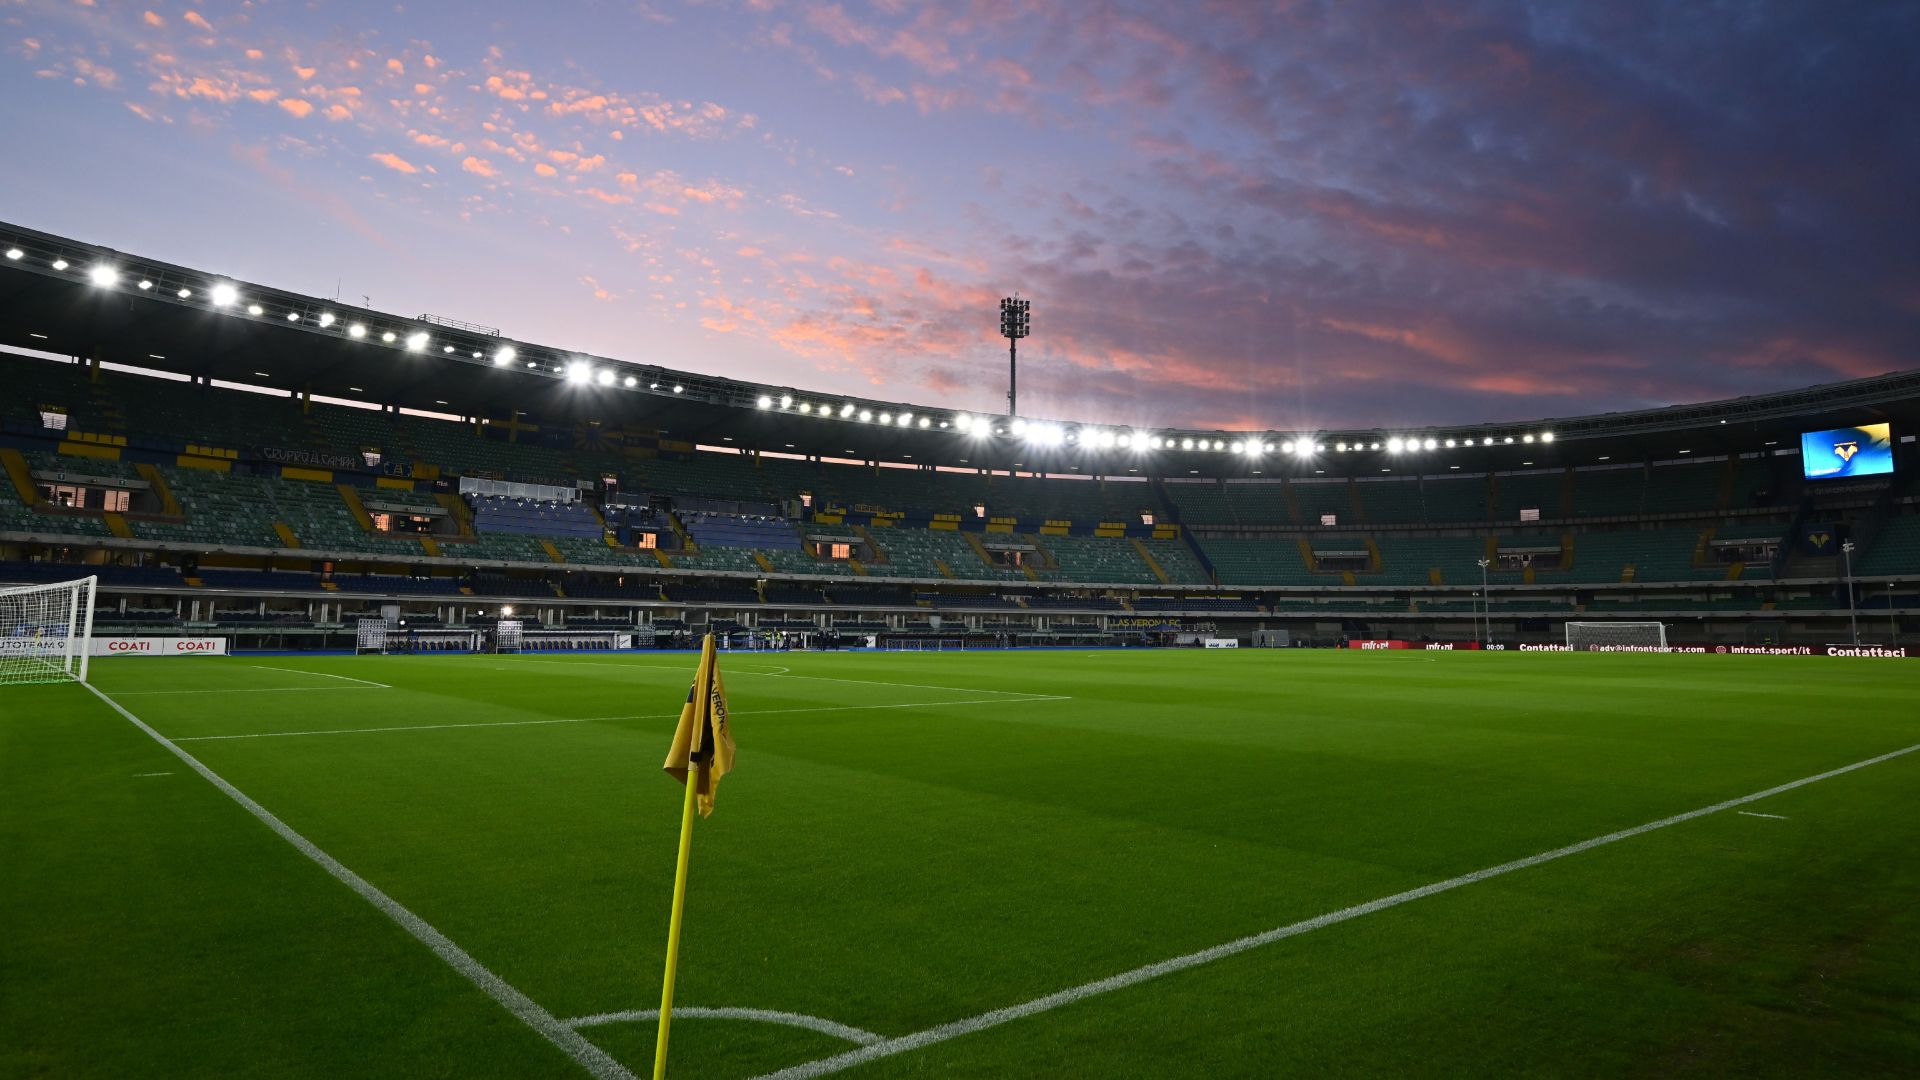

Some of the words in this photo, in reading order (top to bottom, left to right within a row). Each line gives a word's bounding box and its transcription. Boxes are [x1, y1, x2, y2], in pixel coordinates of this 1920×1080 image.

[1107, 619, 1130, 627] LLAS
[1130, 618, 1167, 628] VERONA
[0, 641, 55, 649] UTOTEAM
[108, 641, 151, 651] COATI
[176, 641, 215, 651] COATI
[1731, 645, 1811, 656] infront.sport/it
[1827, 648, 1905, 657] Contattaci
